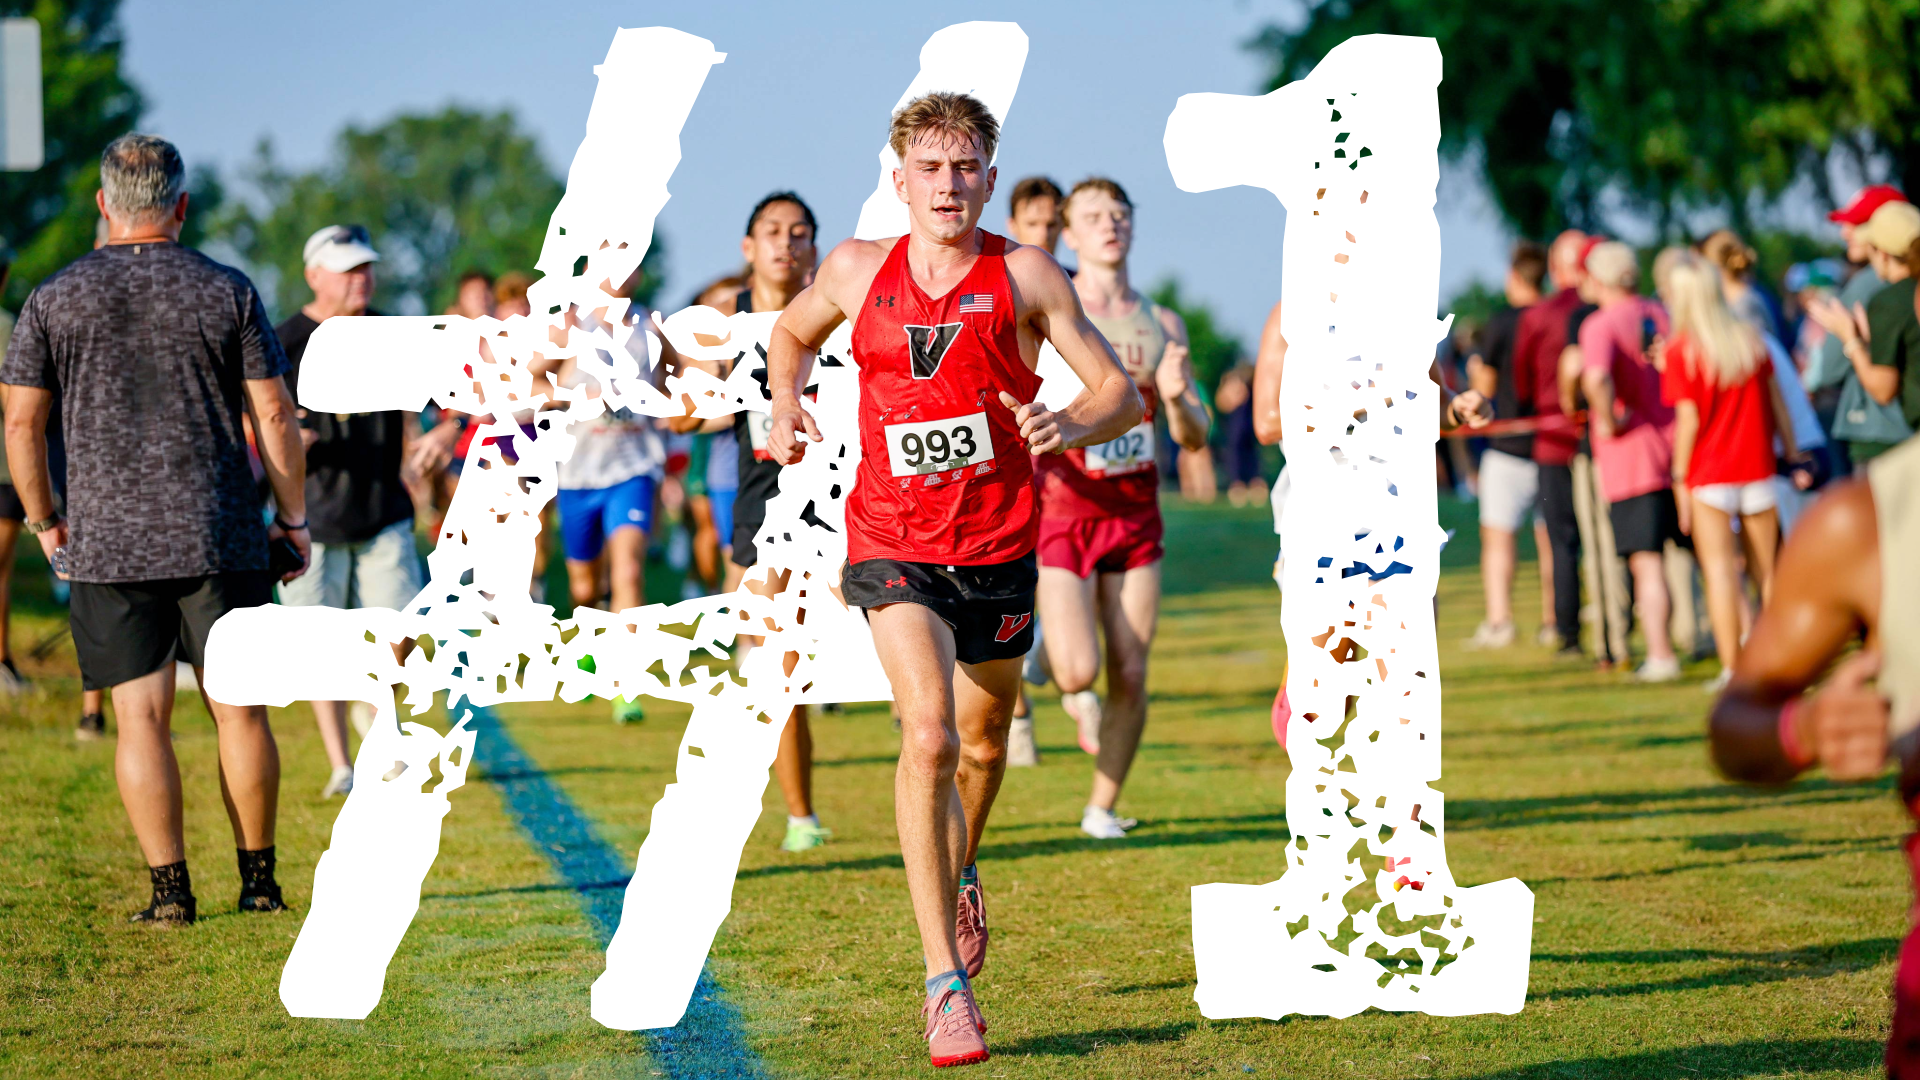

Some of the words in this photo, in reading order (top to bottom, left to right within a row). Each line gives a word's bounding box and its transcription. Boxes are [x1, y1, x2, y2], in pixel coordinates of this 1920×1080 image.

[903, 322, 964, 380] V
[901, 425, 977, 468] 993
[994, 611, 1031, 643] V
